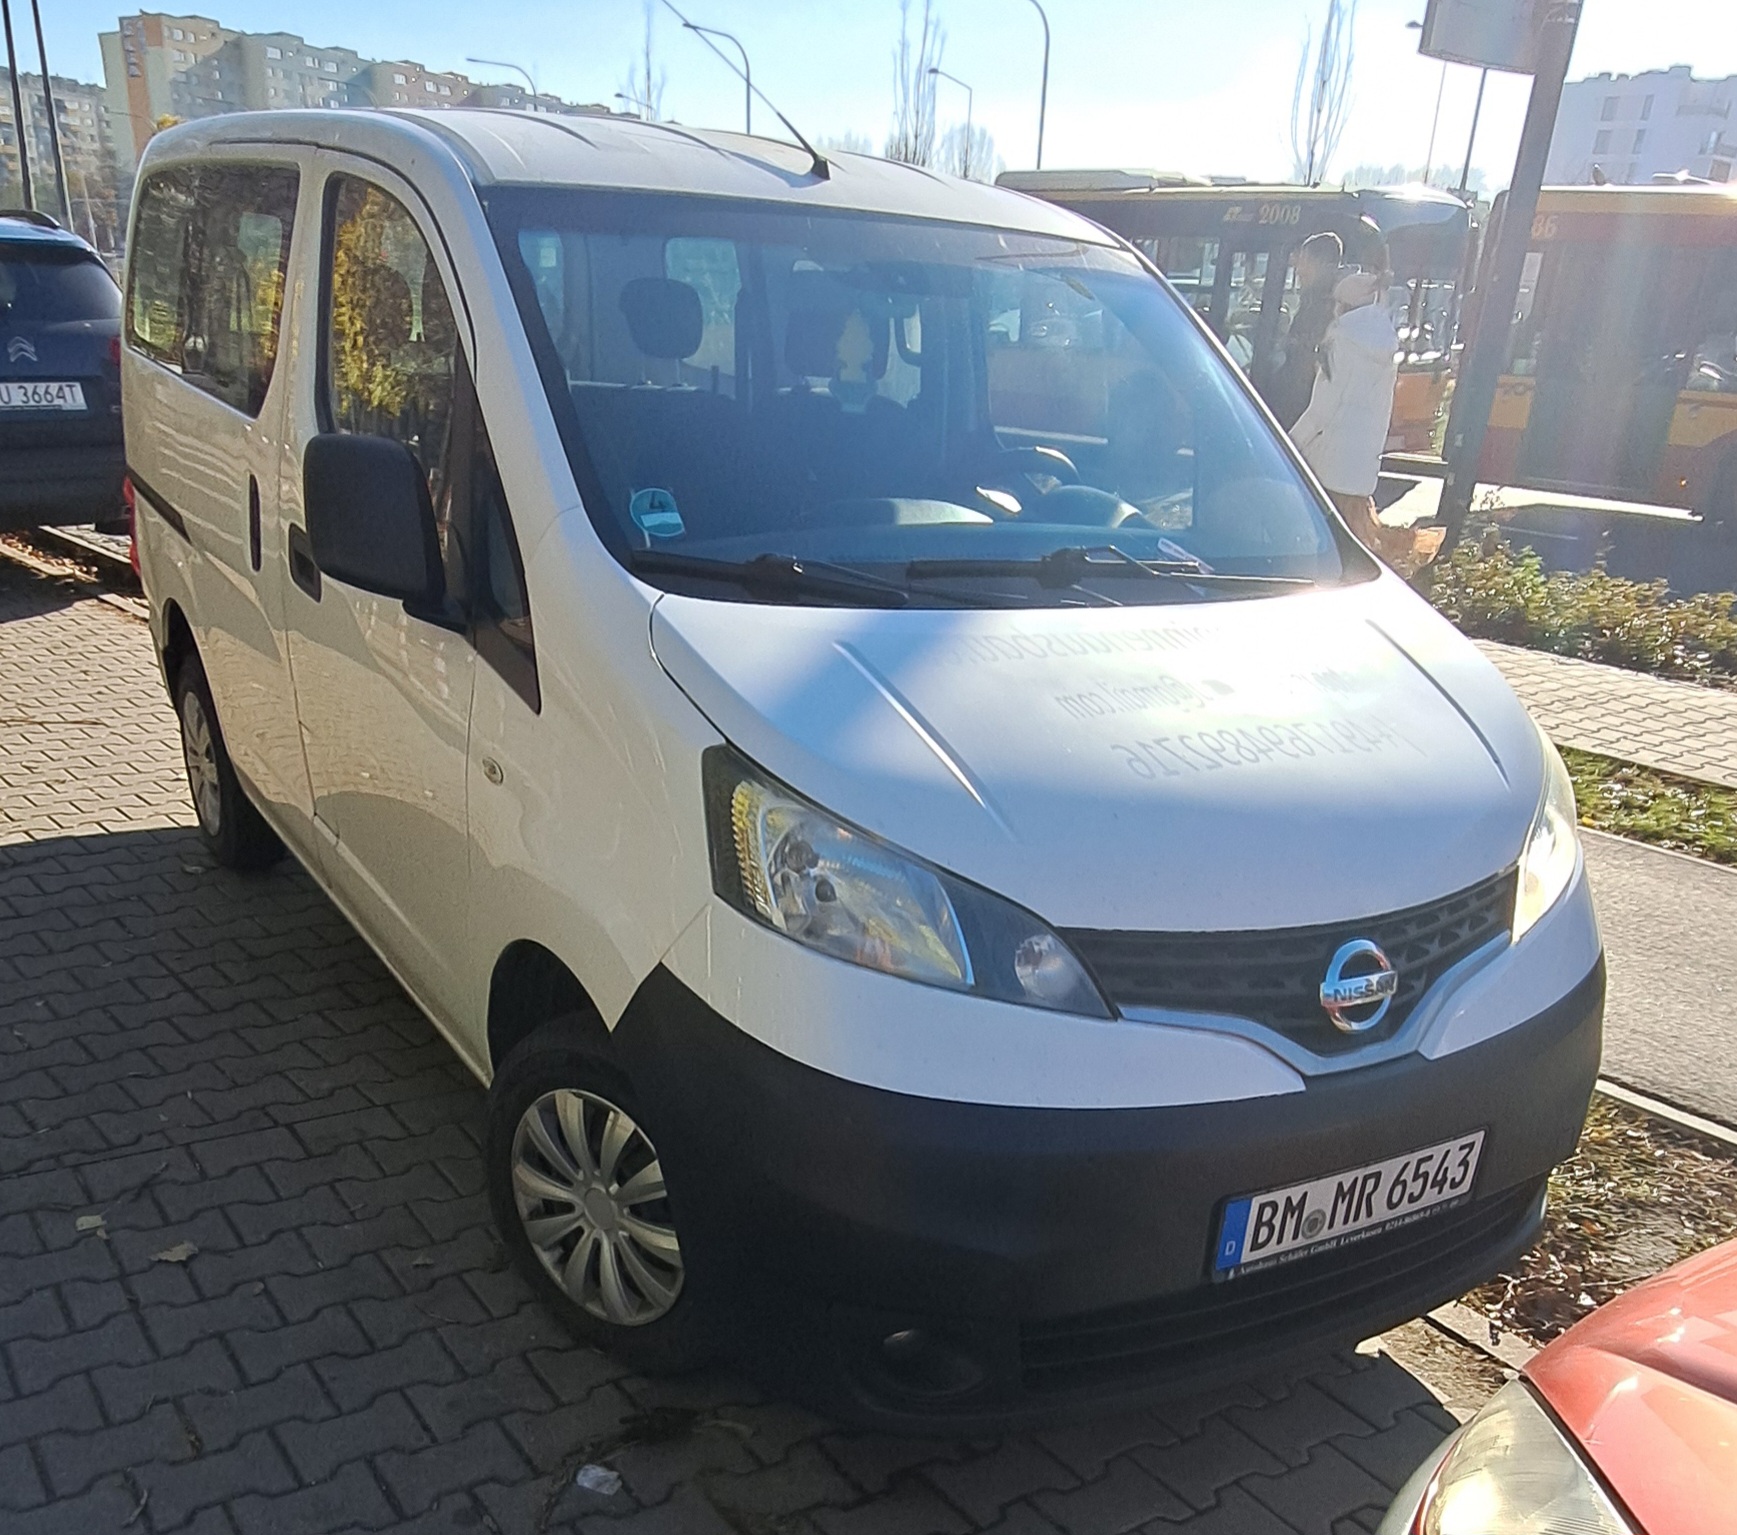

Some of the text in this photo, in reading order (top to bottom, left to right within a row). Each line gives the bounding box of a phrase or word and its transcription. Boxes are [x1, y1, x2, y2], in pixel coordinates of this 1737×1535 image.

[1259, 204, 1301, 224] 2008
[18, 384, 77, 404] 3664T
[1333, 980, 1395, 1002] NISSAN
[1225, 1141, 1476, 1255] D BM MR 6543
